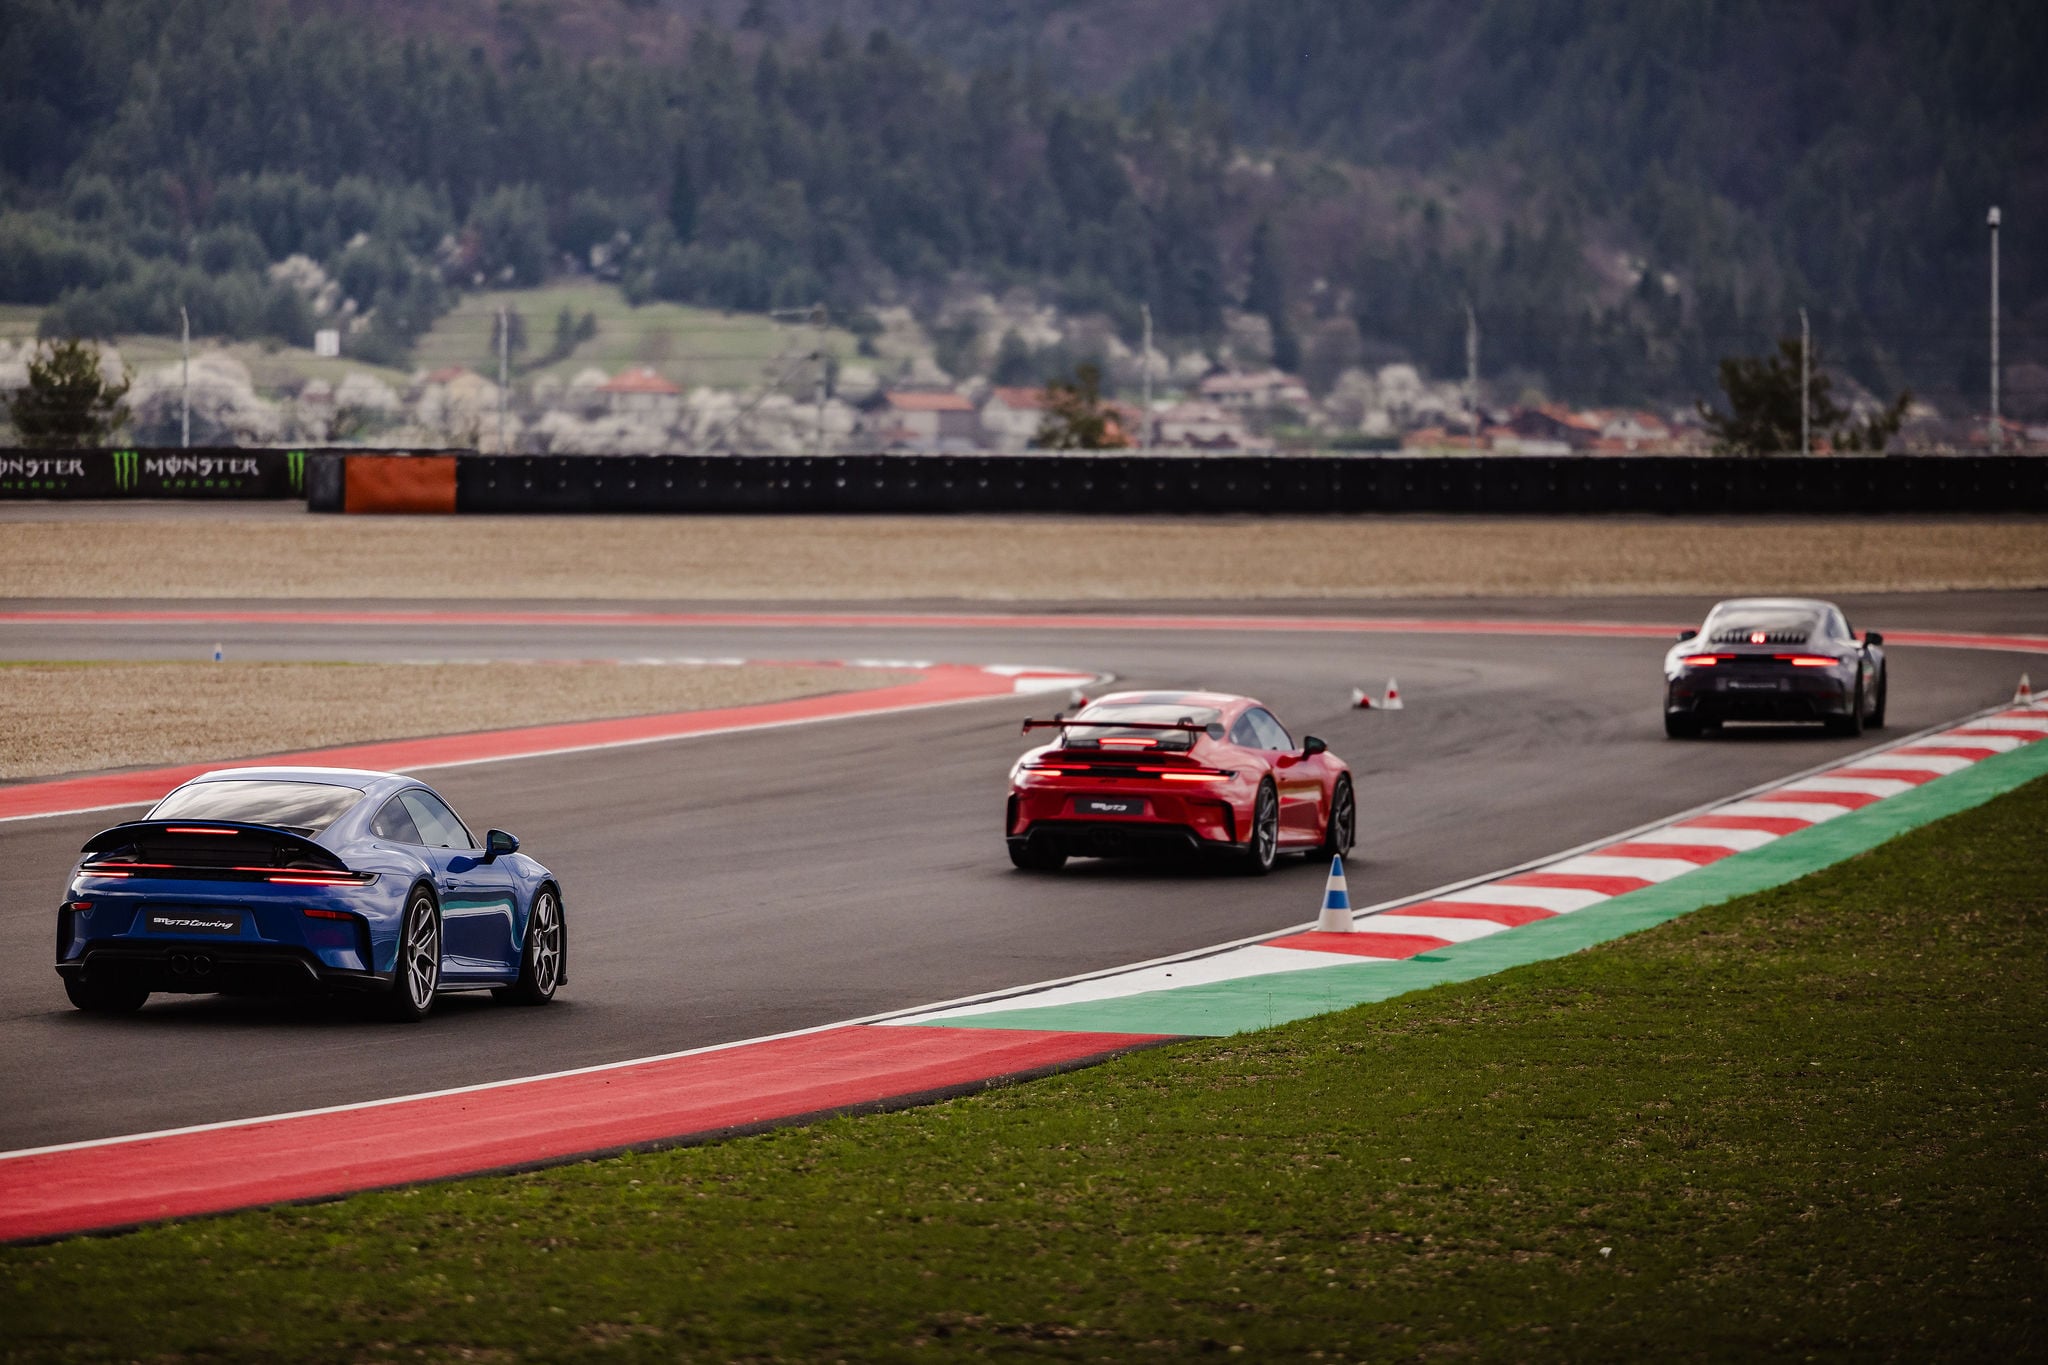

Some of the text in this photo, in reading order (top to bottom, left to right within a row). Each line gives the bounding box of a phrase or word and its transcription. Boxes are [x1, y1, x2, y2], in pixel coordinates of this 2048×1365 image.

[0, 456, 85, 478] NSTER
[145, 455, 260, 478] MONSTER
[2, 480, 68, 489] NERGY
